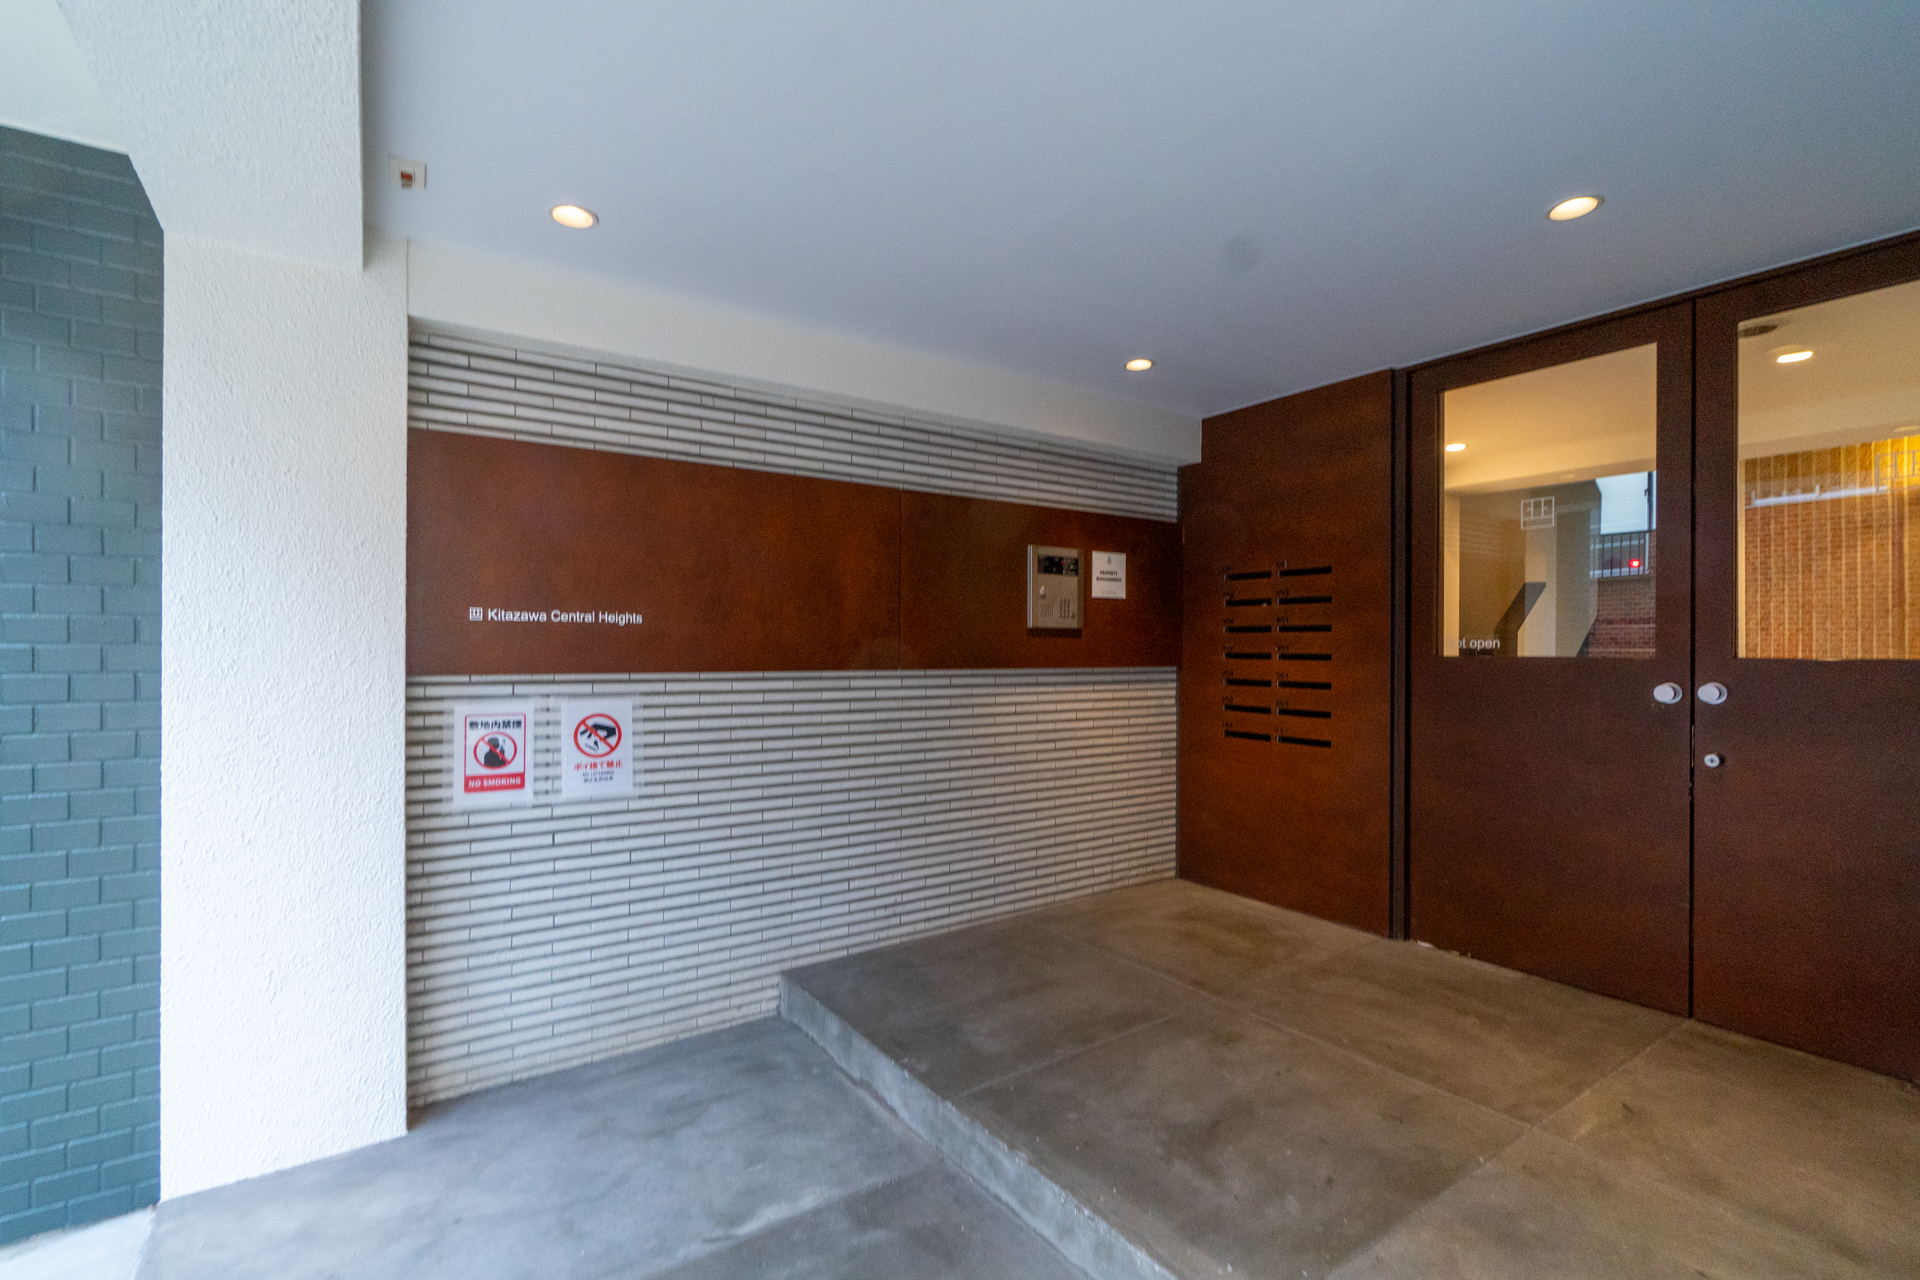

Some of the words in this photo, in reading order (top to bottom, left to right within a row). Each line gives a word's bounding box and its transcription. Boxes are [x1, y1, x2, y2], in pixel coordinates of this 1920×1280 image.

[487, 607, 547, 622] Kitazawa
[550, 609, 595, 623] Central
[598, 611, 643, 627] Heights
[1469, 638, 1501, 651] open
[468, 778, 482, 788] NO
[483, 776, 522, 787] SMOKING
